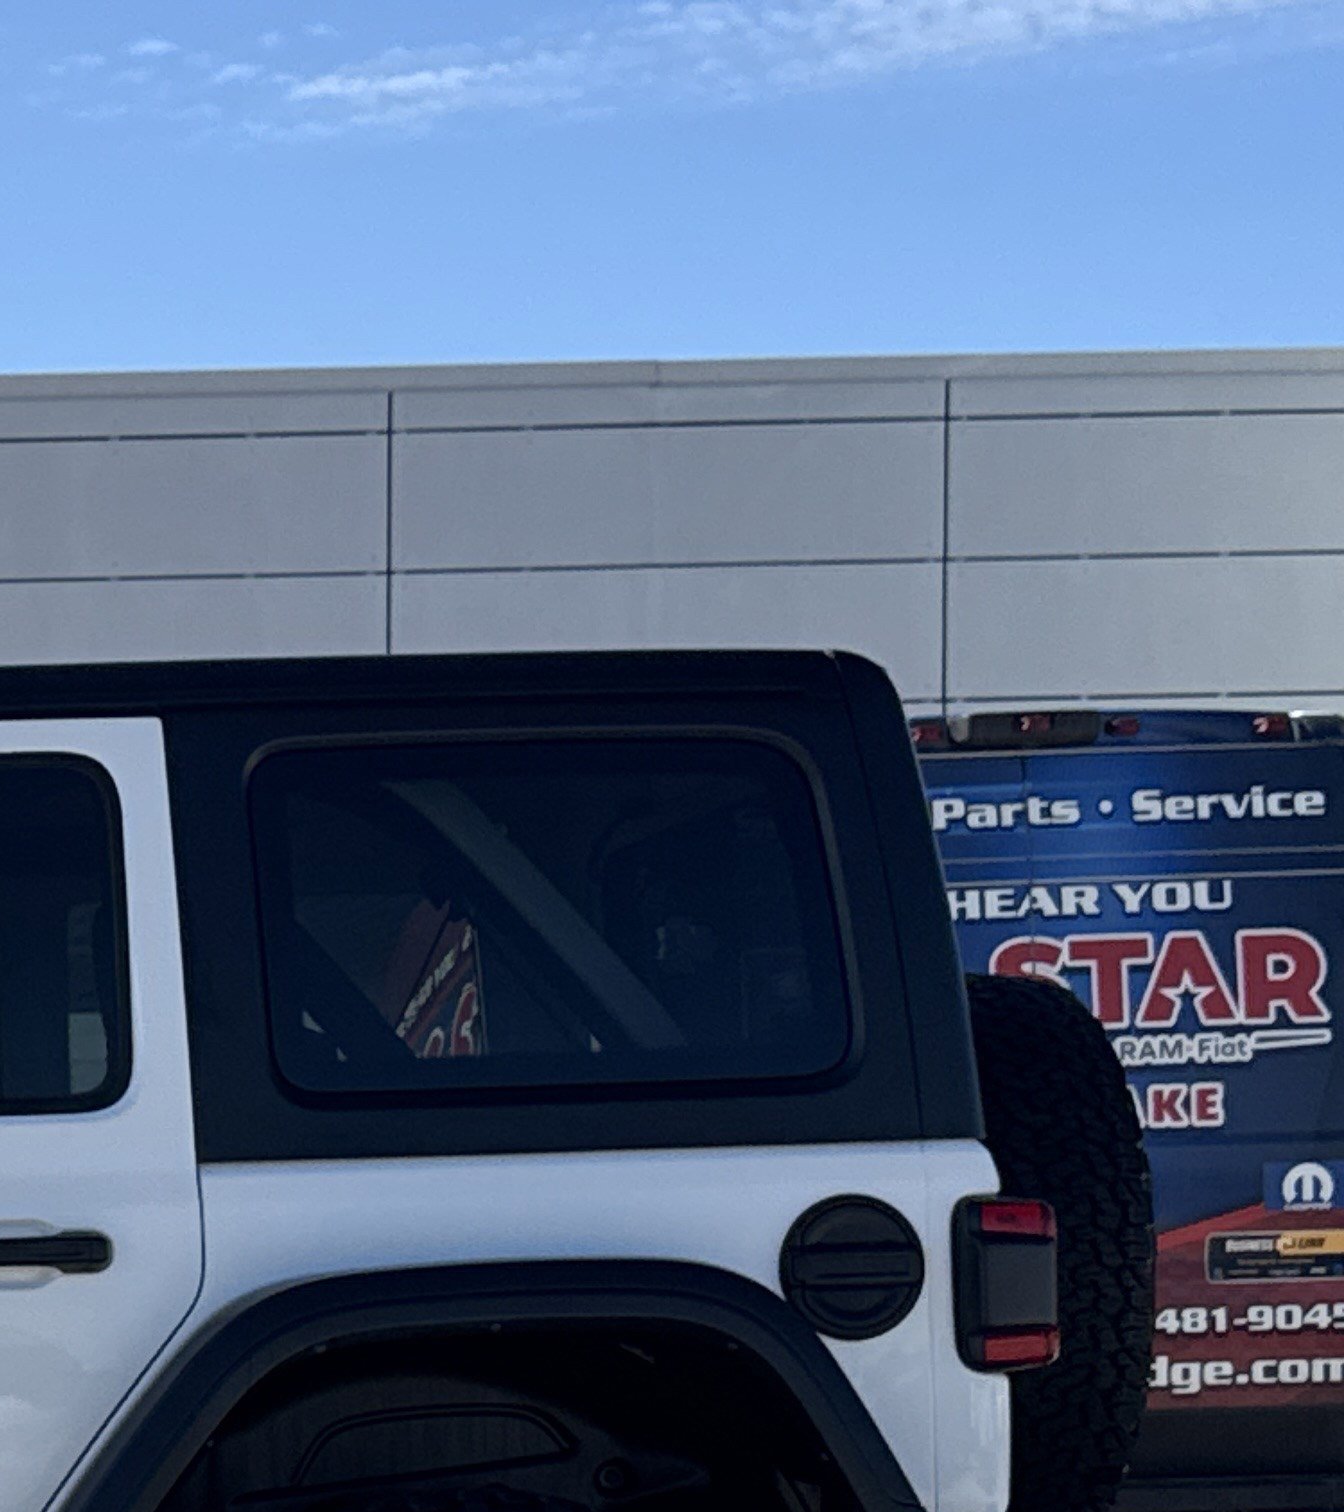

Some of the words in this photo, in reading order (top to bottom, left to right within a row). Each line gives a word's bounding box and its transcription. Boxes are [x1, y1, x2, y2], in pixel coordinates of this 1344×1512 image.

[931, 797, 1081, 831] Parts
[1132, 785, 1326, 822] Service
[948, 885, 1100, 920] HEAR
[1114, 880, 1233, 914] YOU
